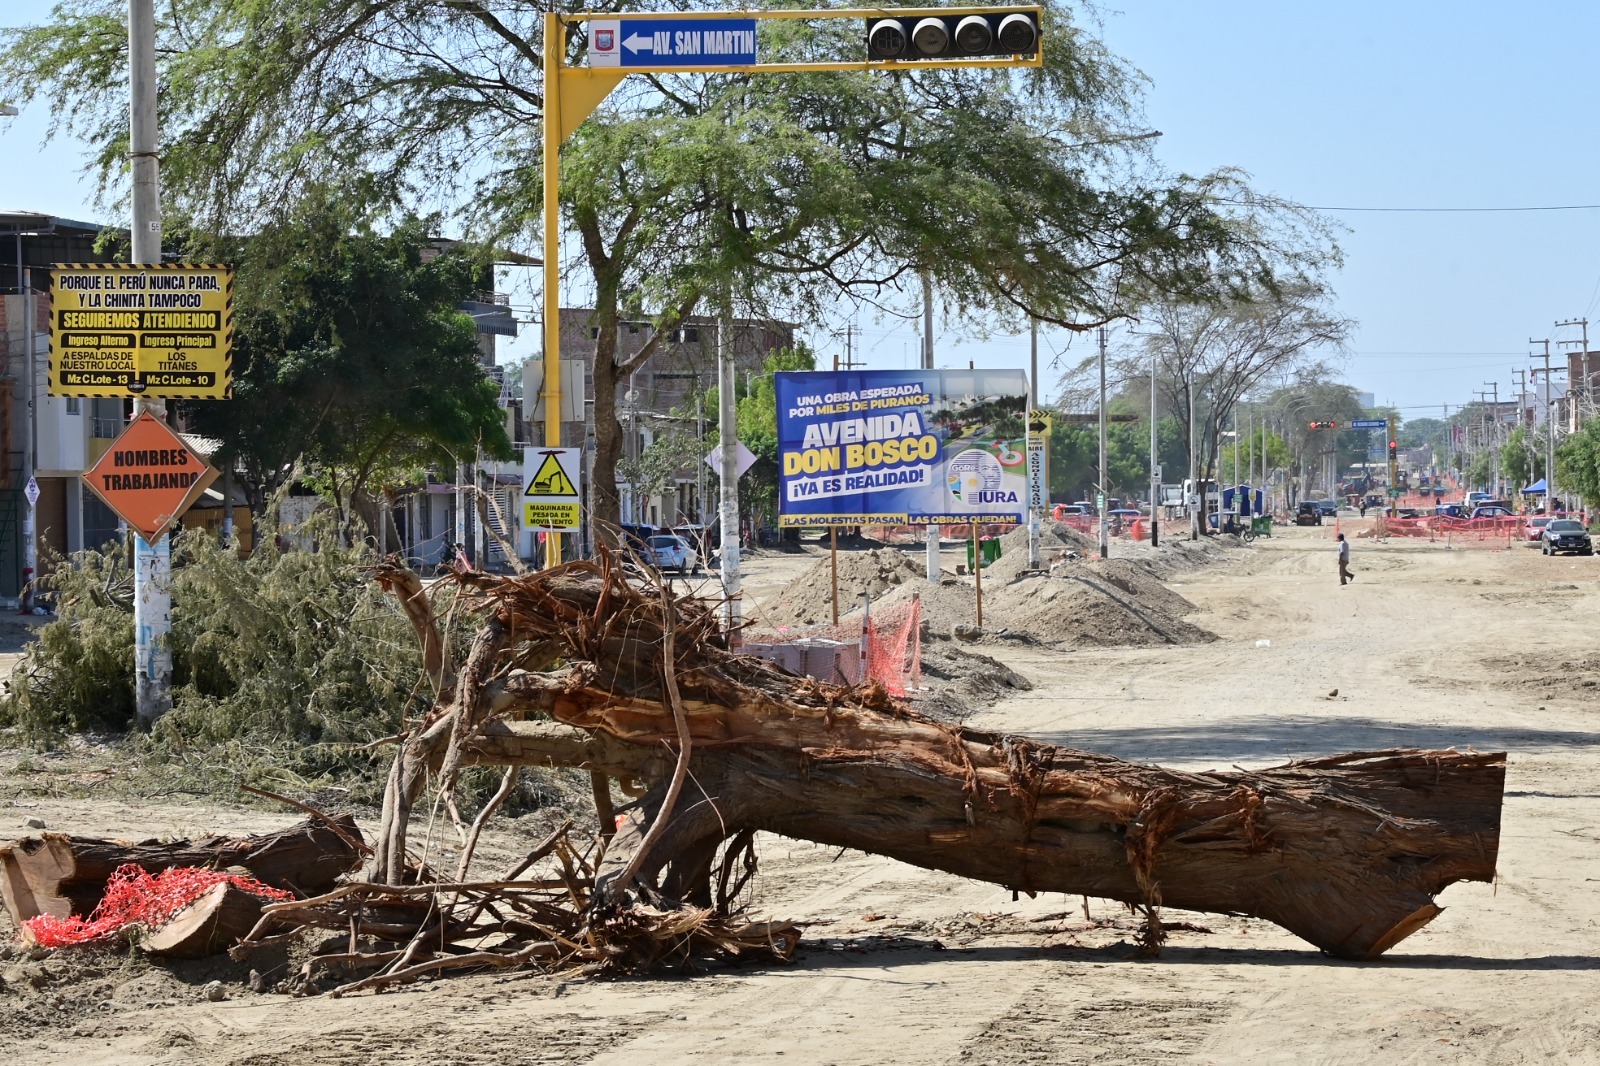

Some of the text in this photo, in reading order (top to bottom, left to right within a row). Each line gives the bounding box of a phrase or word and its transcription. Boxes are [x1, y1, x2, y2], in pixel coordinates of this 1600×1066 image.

[653, 30, 754, 55] AV. SAN MARTIN
[60, 271, 220, 291] PORQUE EL PERÚ NUNCA PARA,
[79, 294, 202, 308] Y LA CHINITA TAMPOCO
[63, 312, 216, 329] SEGUIREMOS ATENDIENDO
[68, 336, 129, 347] Ingreso Alterno
[144, 336, 212, 347] Ingreso Principal
[63, 352, 133, 360] A ESPALDAS DE
[168, 352, 187, 361] LOS
[60, 361, 136, 370] NUESTRO LOCAL
[158, 361, 197, 371] TITANES
[67, 374, 81, 384] Mz
[83, 374, 90, 384] C
[91, 374, 112, 384] Lote
[117, 374, 128, 384] 13
[147, 375, 161, 385] Mz
[162, 375, 170, 385] C
[170, 375, 192, 385] Lote
[197, 375, 208, 385] 10
[797, 384, 922, 406] UNA OBRA ESPERADA
[789, 394, 930, 418] POR MILES DE PIURANOS
[802, 412, 922, 449] AVENIDA
[114, 448, 188, 467] HOMBRES
[783, 435, 938, 476] DON BOSCO
[793, 469, 924, 498] ¡YA ES REALIDAD!
[784, 515, 1017, 526] ¡LAS MOLESTIAS PASAN, LAS OBRAS QUEDAN!
